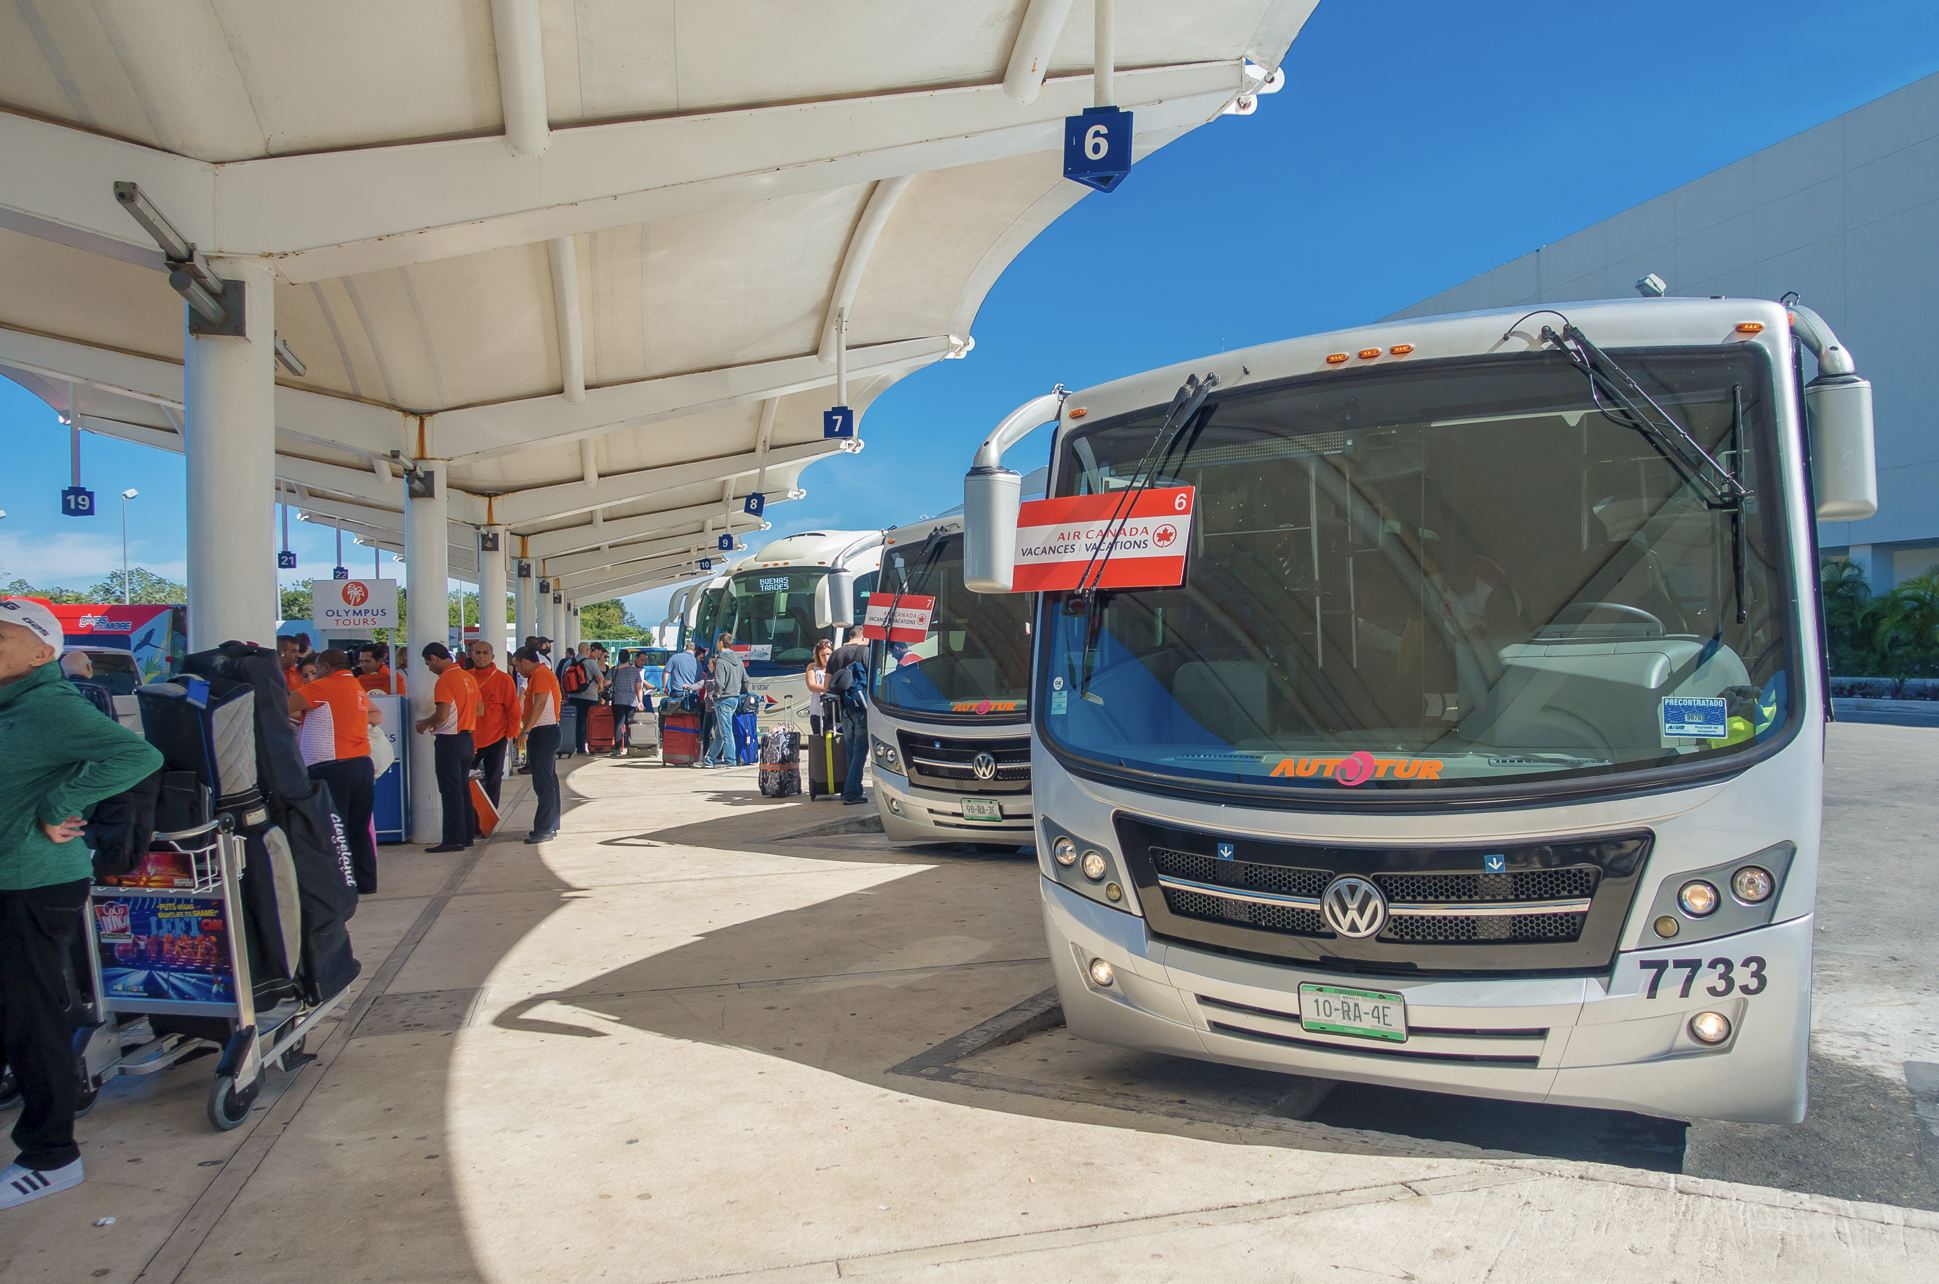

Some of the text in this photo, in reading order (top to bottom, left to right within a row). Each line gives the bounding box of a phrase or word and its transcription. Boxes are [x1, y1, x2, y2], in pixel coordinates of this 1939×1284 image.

[1084, 124, 1109, 160] 6
[832, 415, 843, 432] 7
[66, 495, 90, 510] 19
[750, 498, 758, 510] 8
[1174, 493, 1187, 511] 6
[1057, 526, 1149, 542] AIR CANADA
[722, 538, 729, 548] 9
[1021, 539, 1149, 557] VACANCES VACATIONS
[280, 555, 294, 566] 21
[701, 561, 710, 569] 10
[335, 570, 346, 579] 22
[760, 577, 789, 585] BUENAS
[760, 583, 789, 591] TARDES
[926, 599, 932, 609] 7
[325, 608, 387, 617] OLYMPUS
[106, 621, 133, 631] MORE
[334, 618, 377, 626] TOURS
[1664, 698, 1724, 707] PRECONTRATADO
[1270, 751, 1444, 787] AUTOTUR
[330, 813, 357, 887] Cleveland
[1639, 955, 1768, 1000] 7733
[1314, 998, 1393, 1027] 10-RA-4E
